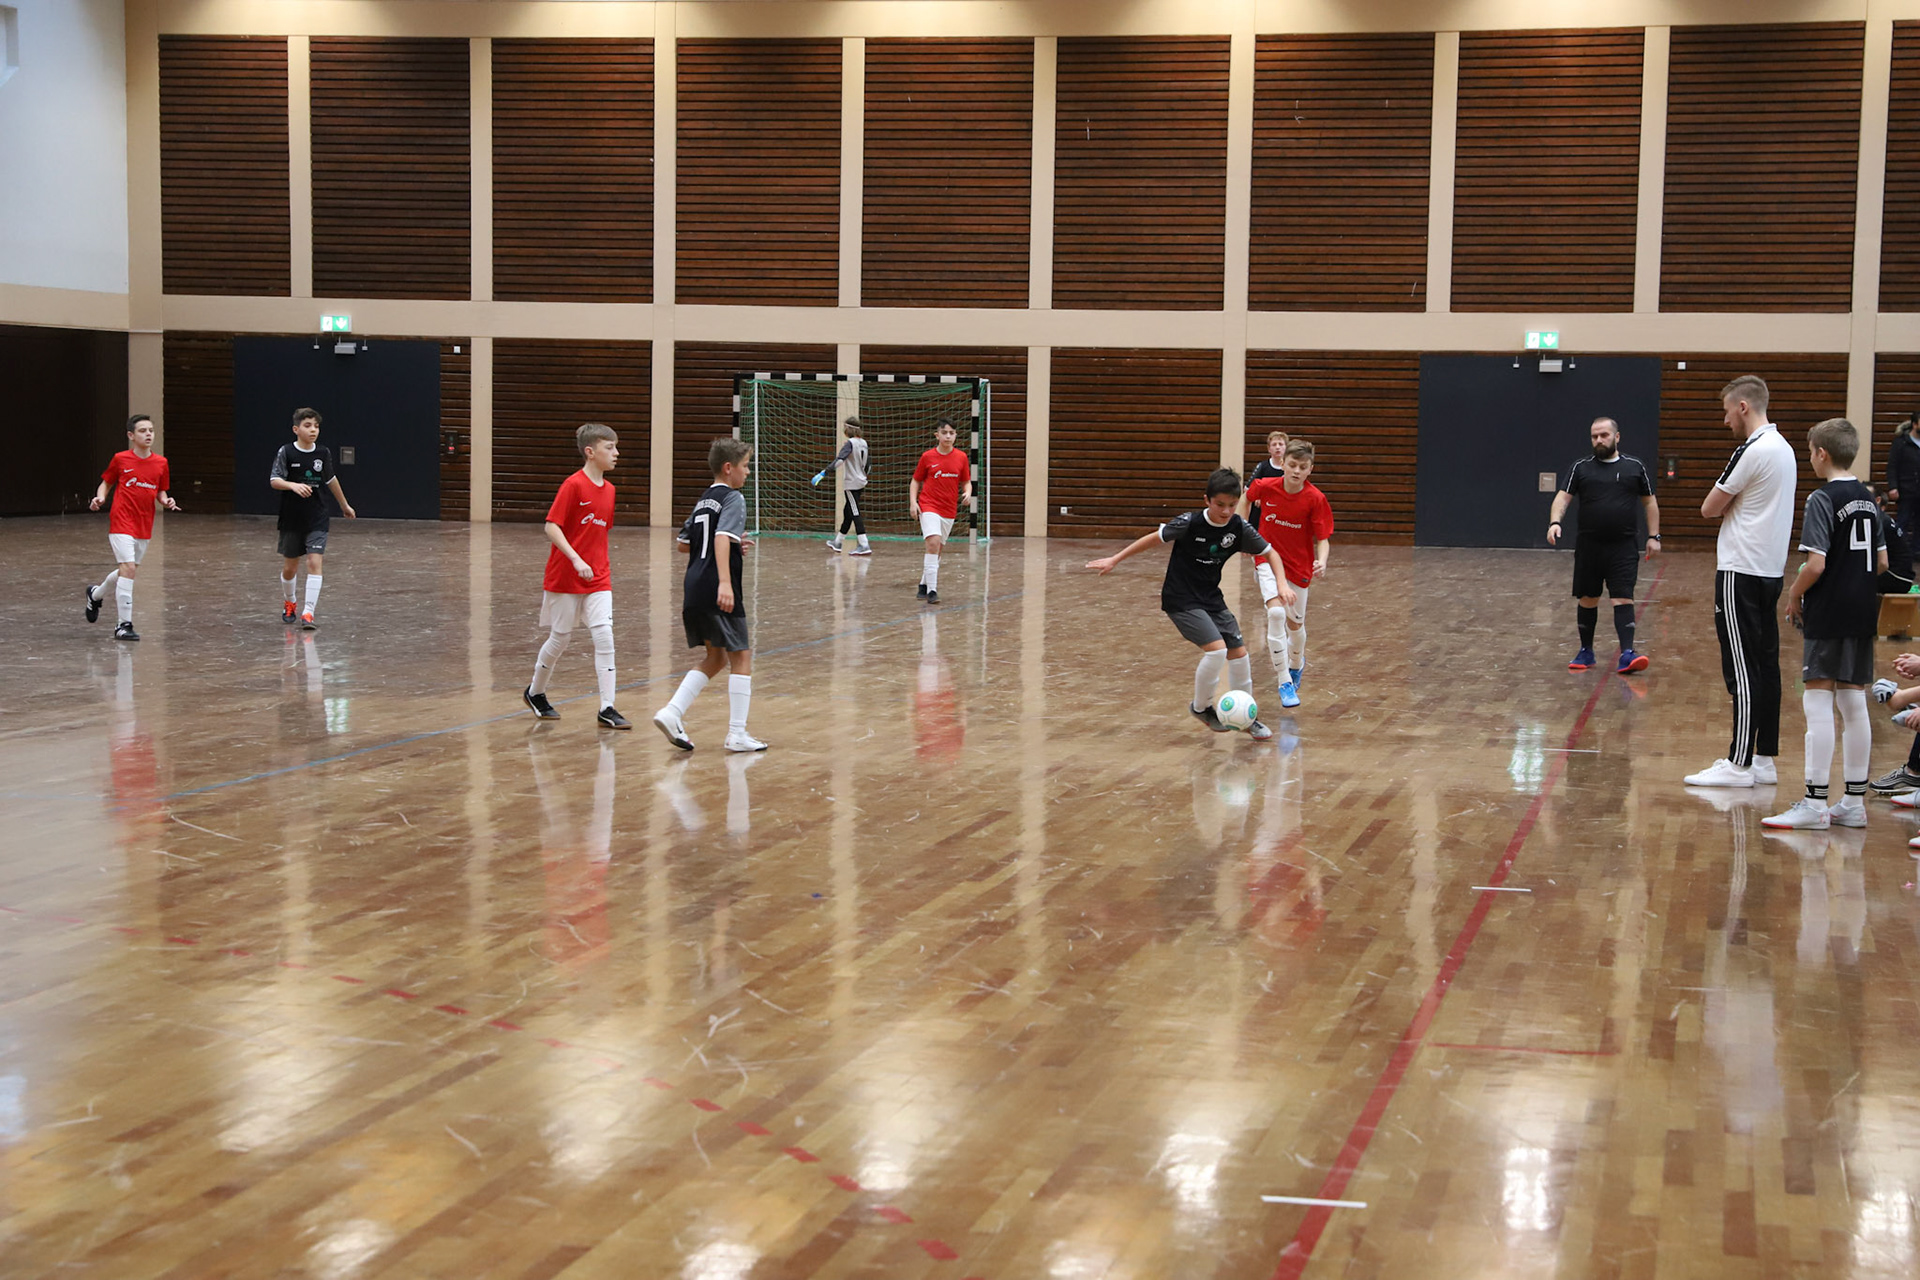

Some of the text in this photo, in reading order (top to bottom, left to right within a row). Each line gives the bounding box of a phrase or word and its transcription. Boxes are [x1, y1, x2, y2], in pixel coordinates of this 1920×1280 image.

[694, 513, 710, 559] 7
[1274, 519, 1302, 529] mainova
[1849, 518, 1872, 572] 4
